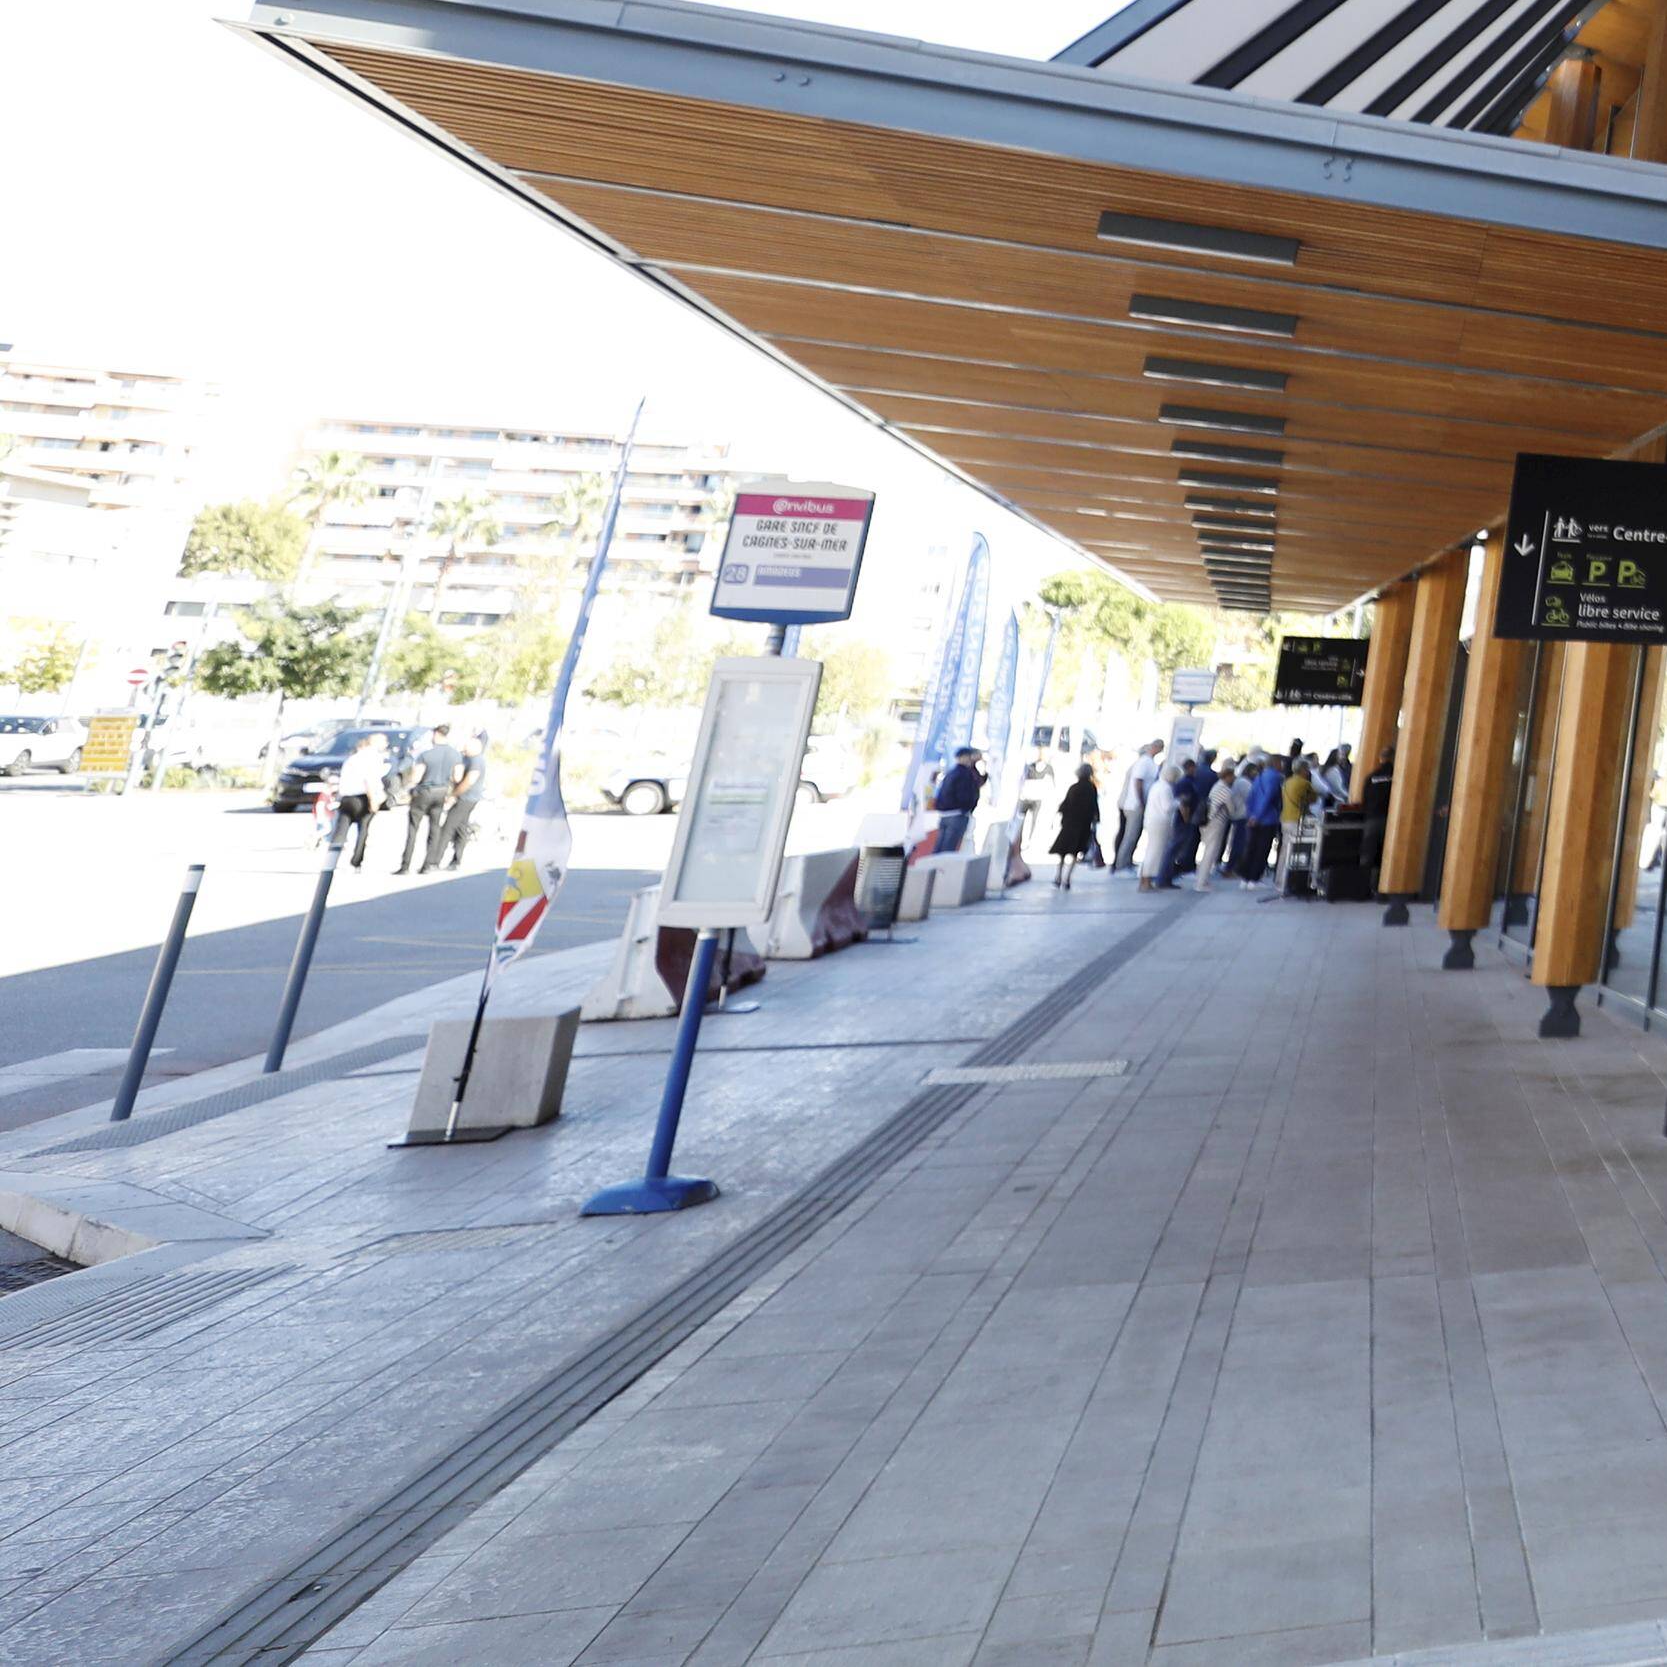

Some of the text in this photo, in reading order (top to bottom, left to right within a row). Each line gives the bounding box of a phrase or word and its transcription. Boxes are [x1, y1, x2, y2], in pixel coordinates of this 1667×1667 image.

[756, 519, 787, 534] GARE
[822, 522, 839, 535] DE
[1587, 523, 1609, 533] vers
[742, 535, 848, 552] CAGNES-SUR-MER
[1579, 592, 1606, 604] Vélos
[1578, 604, 1661, 622] libre service
